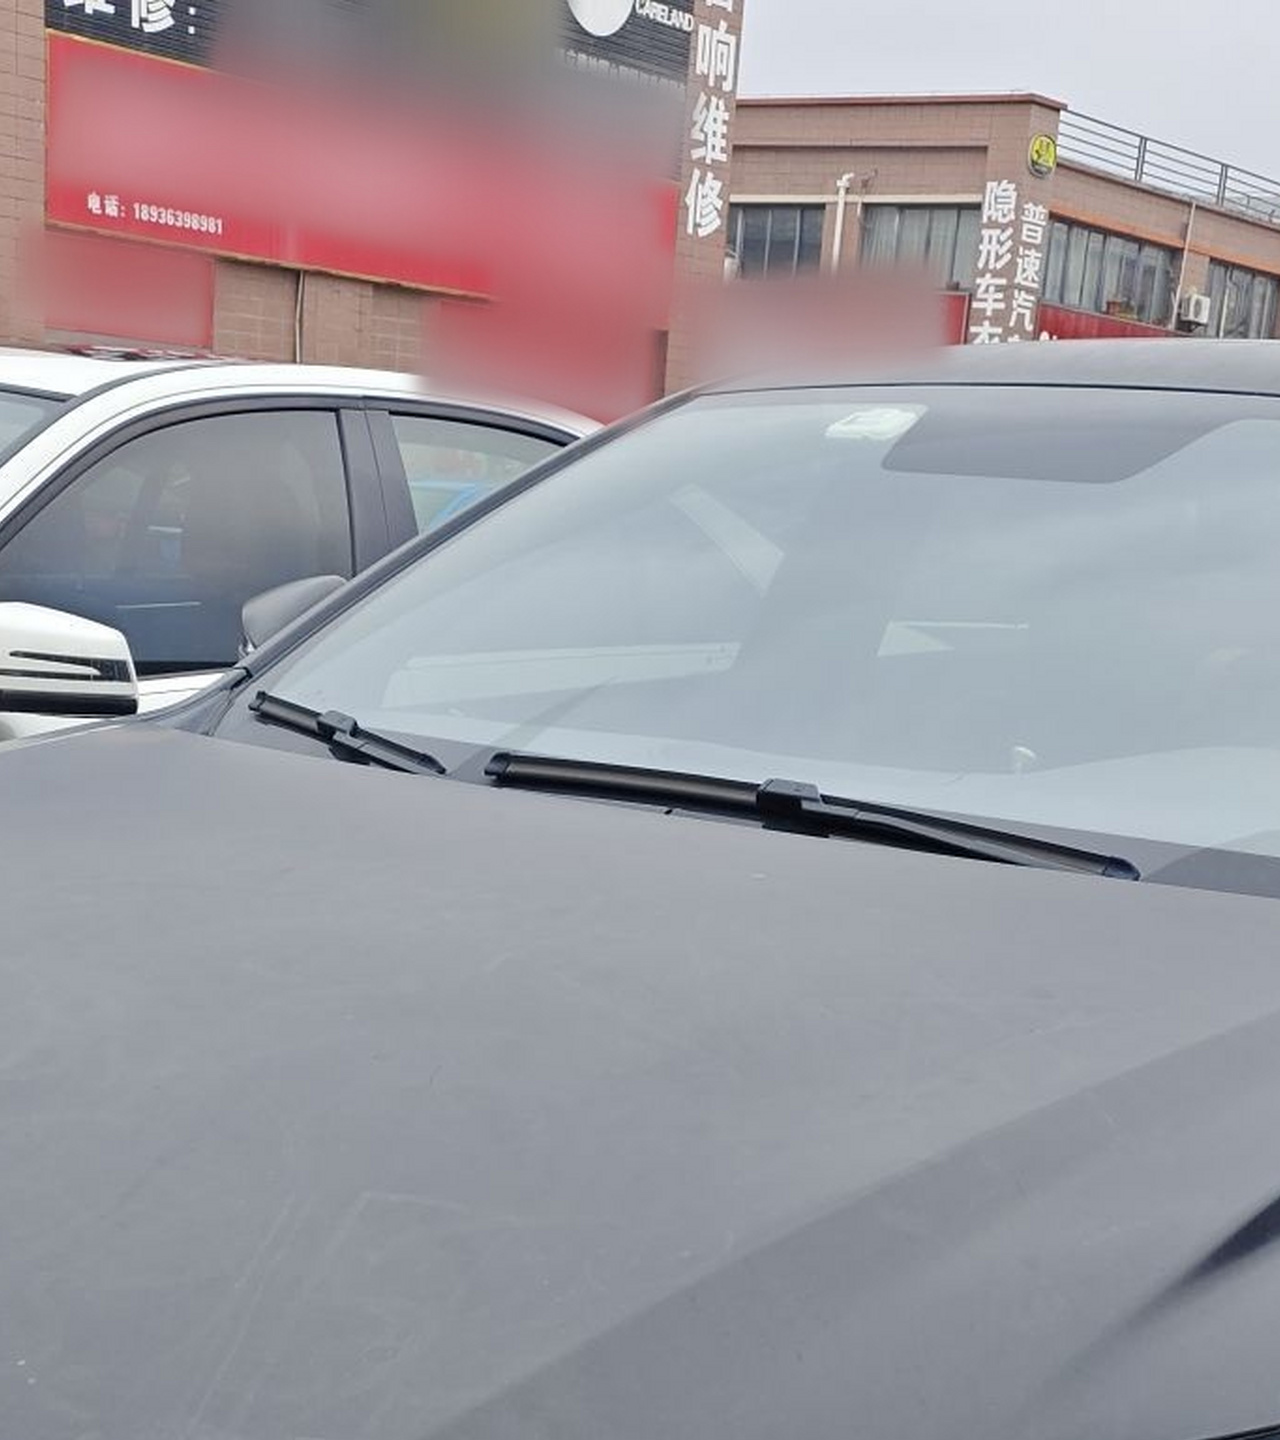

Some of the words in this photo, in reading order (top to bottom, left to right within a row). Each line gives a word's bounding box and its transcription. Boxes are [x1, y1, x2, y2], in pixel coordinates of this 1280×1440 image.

[685, 0, 737, 238] 响维修
[1008, 202, 1048, 344] 普速汽
